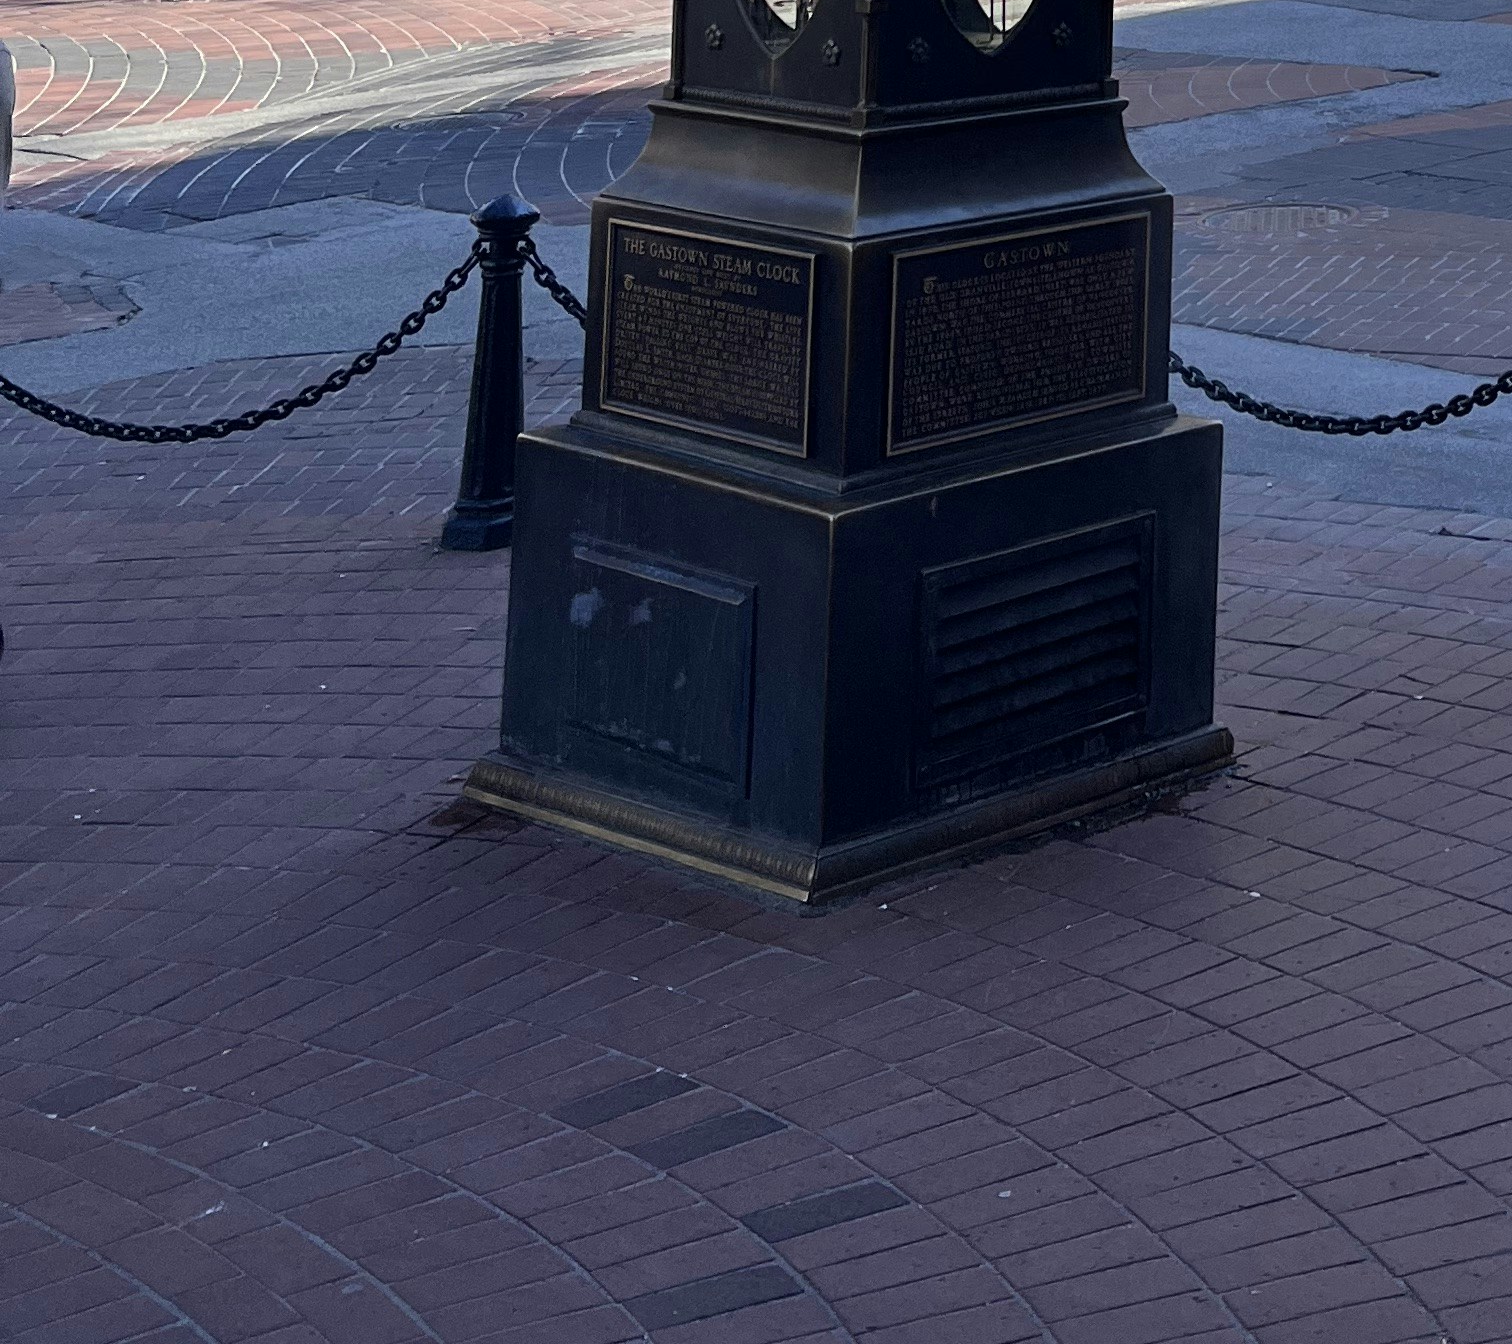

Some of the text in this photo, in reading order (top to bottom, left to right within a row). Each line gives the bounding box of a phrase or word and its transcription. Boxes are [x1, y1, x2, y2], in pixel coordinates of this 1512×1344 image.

[623, 237, 645, 255] THE
[650, 242, 708, 266] GASTOWN
[712, 253, 752, 276] STEAM
[756, 262, 801, 285] CLOCK
[983, 240, 1071, 269] GASTOWN
